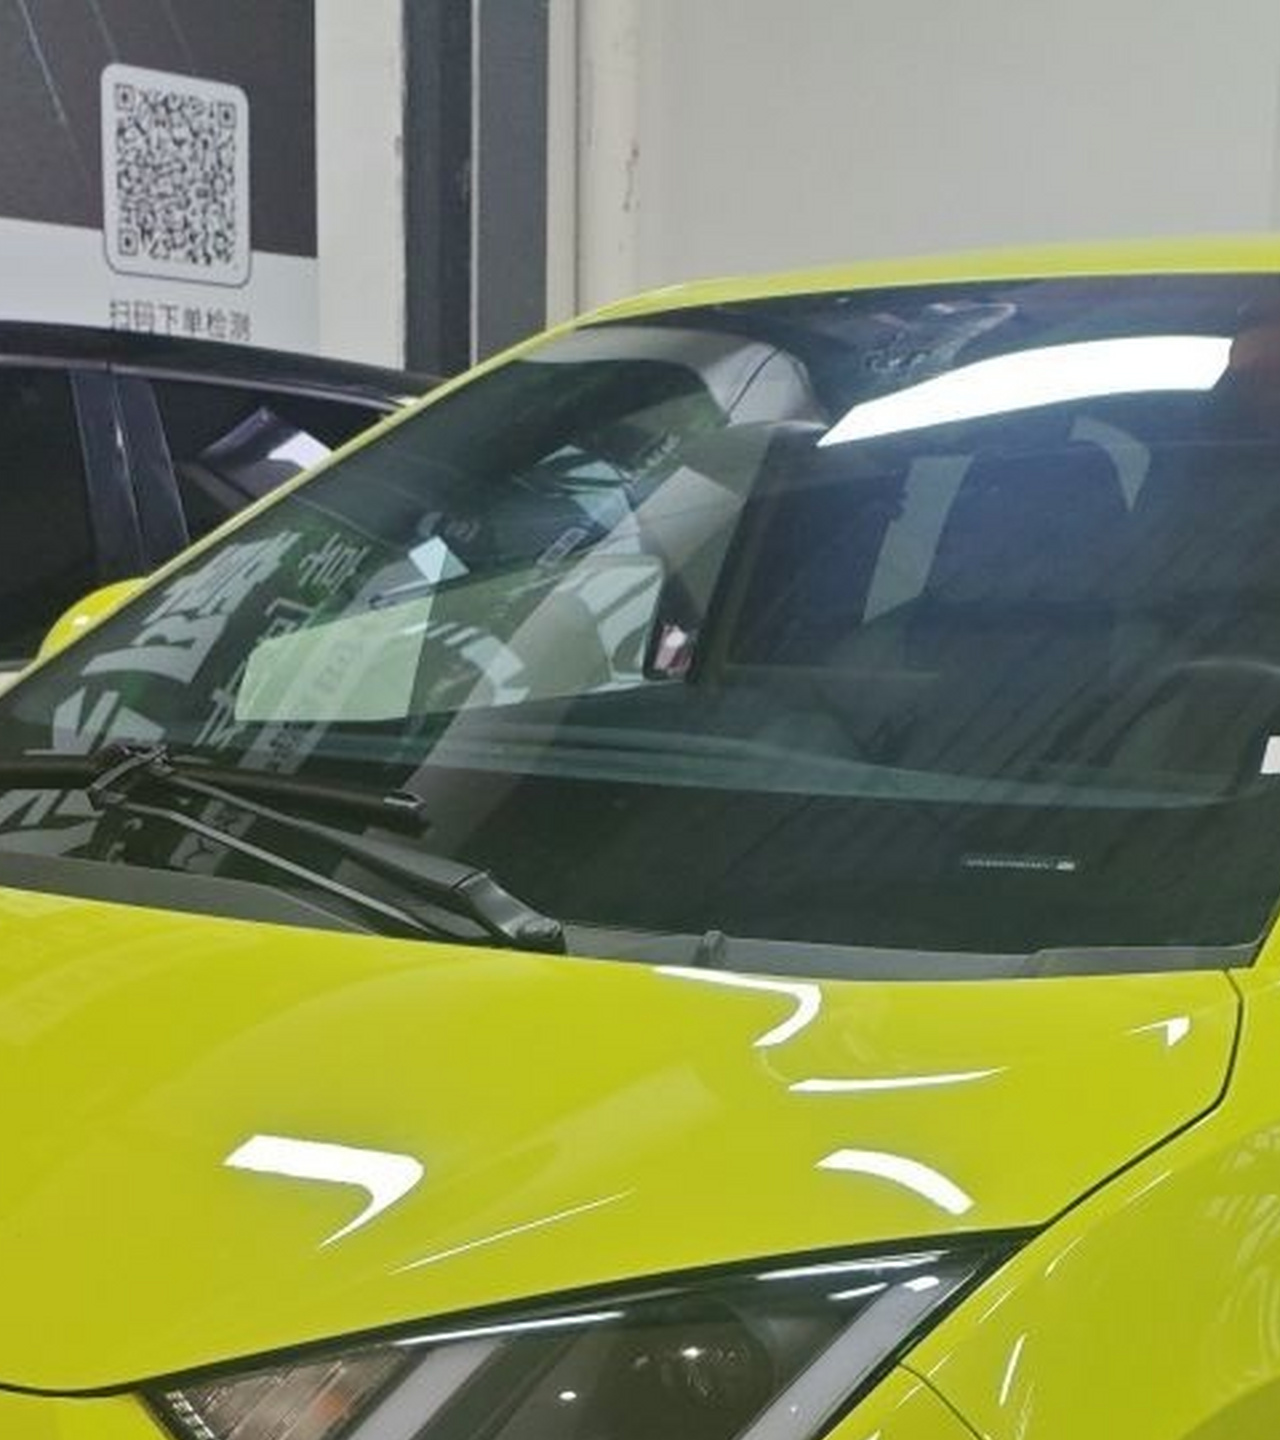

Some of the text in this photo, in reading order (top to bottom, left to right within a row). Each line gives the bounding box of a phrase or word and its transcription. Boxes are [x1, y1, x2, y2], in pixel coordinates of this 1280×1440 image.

[109, 300, 251, 341] 扫码下单检测
